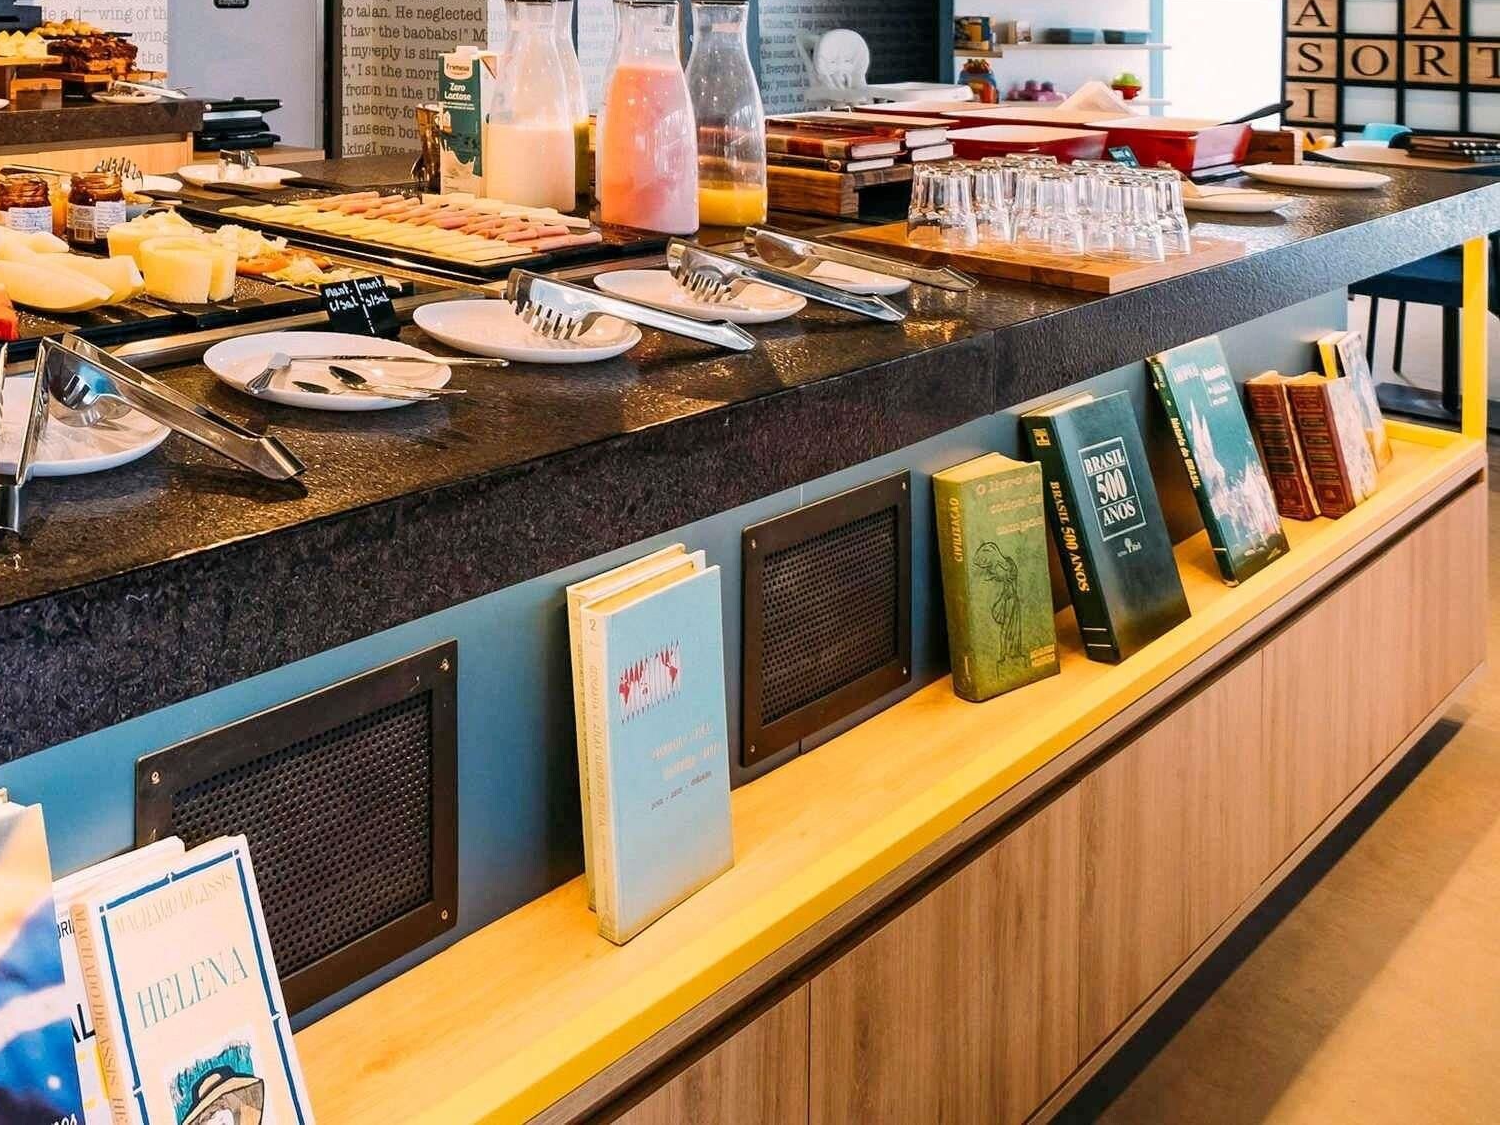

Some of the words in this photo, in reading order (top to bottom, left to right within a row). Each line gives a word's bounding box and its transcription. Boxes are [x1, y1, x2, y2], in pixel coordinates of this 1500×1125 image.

[396, 6, 413, 19] He
[416, 6, 482, 25] neglected
[379, 26, 402, 39] the
[444, 90, 472, 101] Lactose
[450, 82, 466, 92] Zero
[1083, 448, 1126, 475] BRASIL
[1095, 468, 1128, 505] 500
[1049, 481, 1070, 525] BRASIL
[1103, 499, 1136, 527] ANOS
[1060, 526, 1080, 551] 500
[1068, 553, 1091, 592] ANOS
[136, 946, 250, 1030] HELENA
